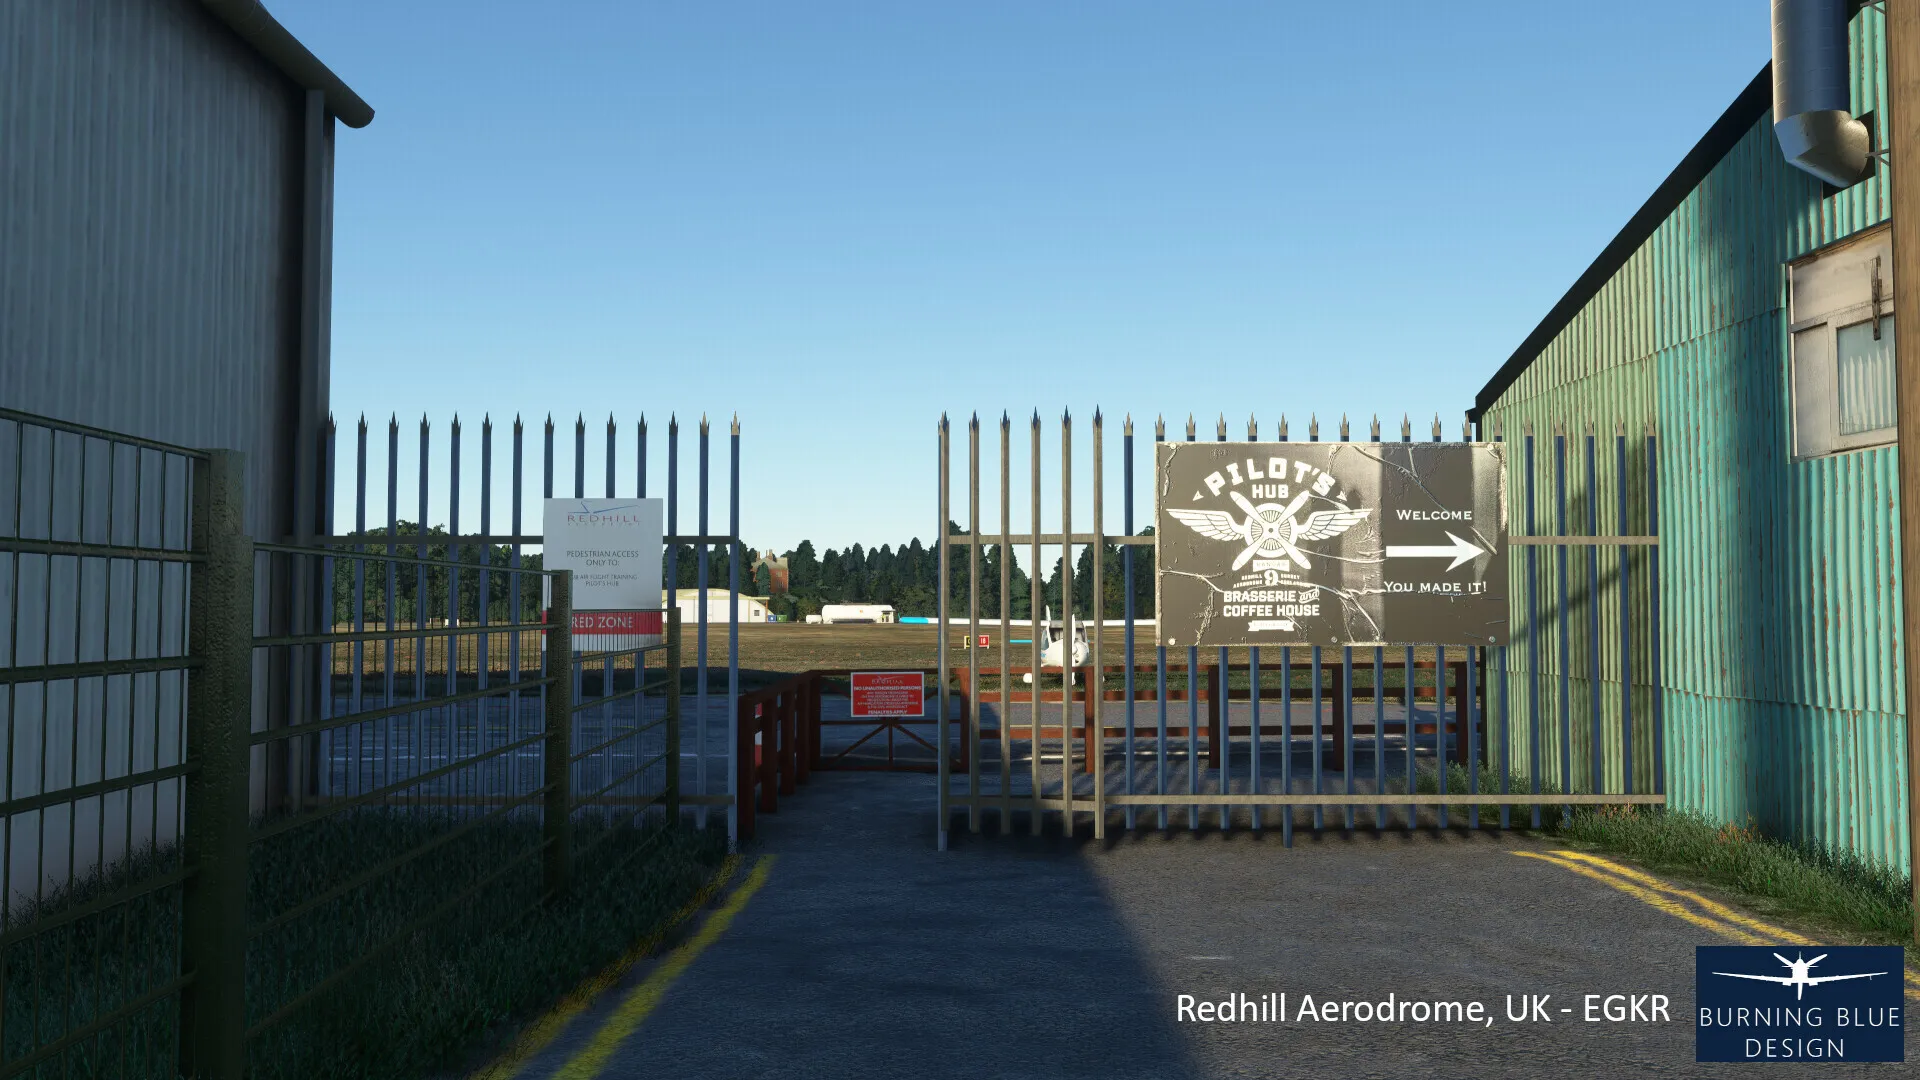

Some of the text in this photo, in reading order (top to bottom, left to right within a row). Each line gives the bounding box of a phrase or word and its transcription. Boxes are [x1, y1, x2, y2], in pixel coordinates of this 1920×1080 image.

[1203, 457, 1336, 497] PILOT'S
[1252, 484, 1289, 499] HUB
[566, 550, 639, 558] PEDESTRIAN ACCESS
[586, 559, 620, 567] ONLY TO:
[1264, 569, 1279, 587] 9
[1223, 585, 1320, 604] BRASSERIE and
[1223, 604, 1320, 617] COFFEE HOUSE
[572, 616, 633, 628] RED ZONE
